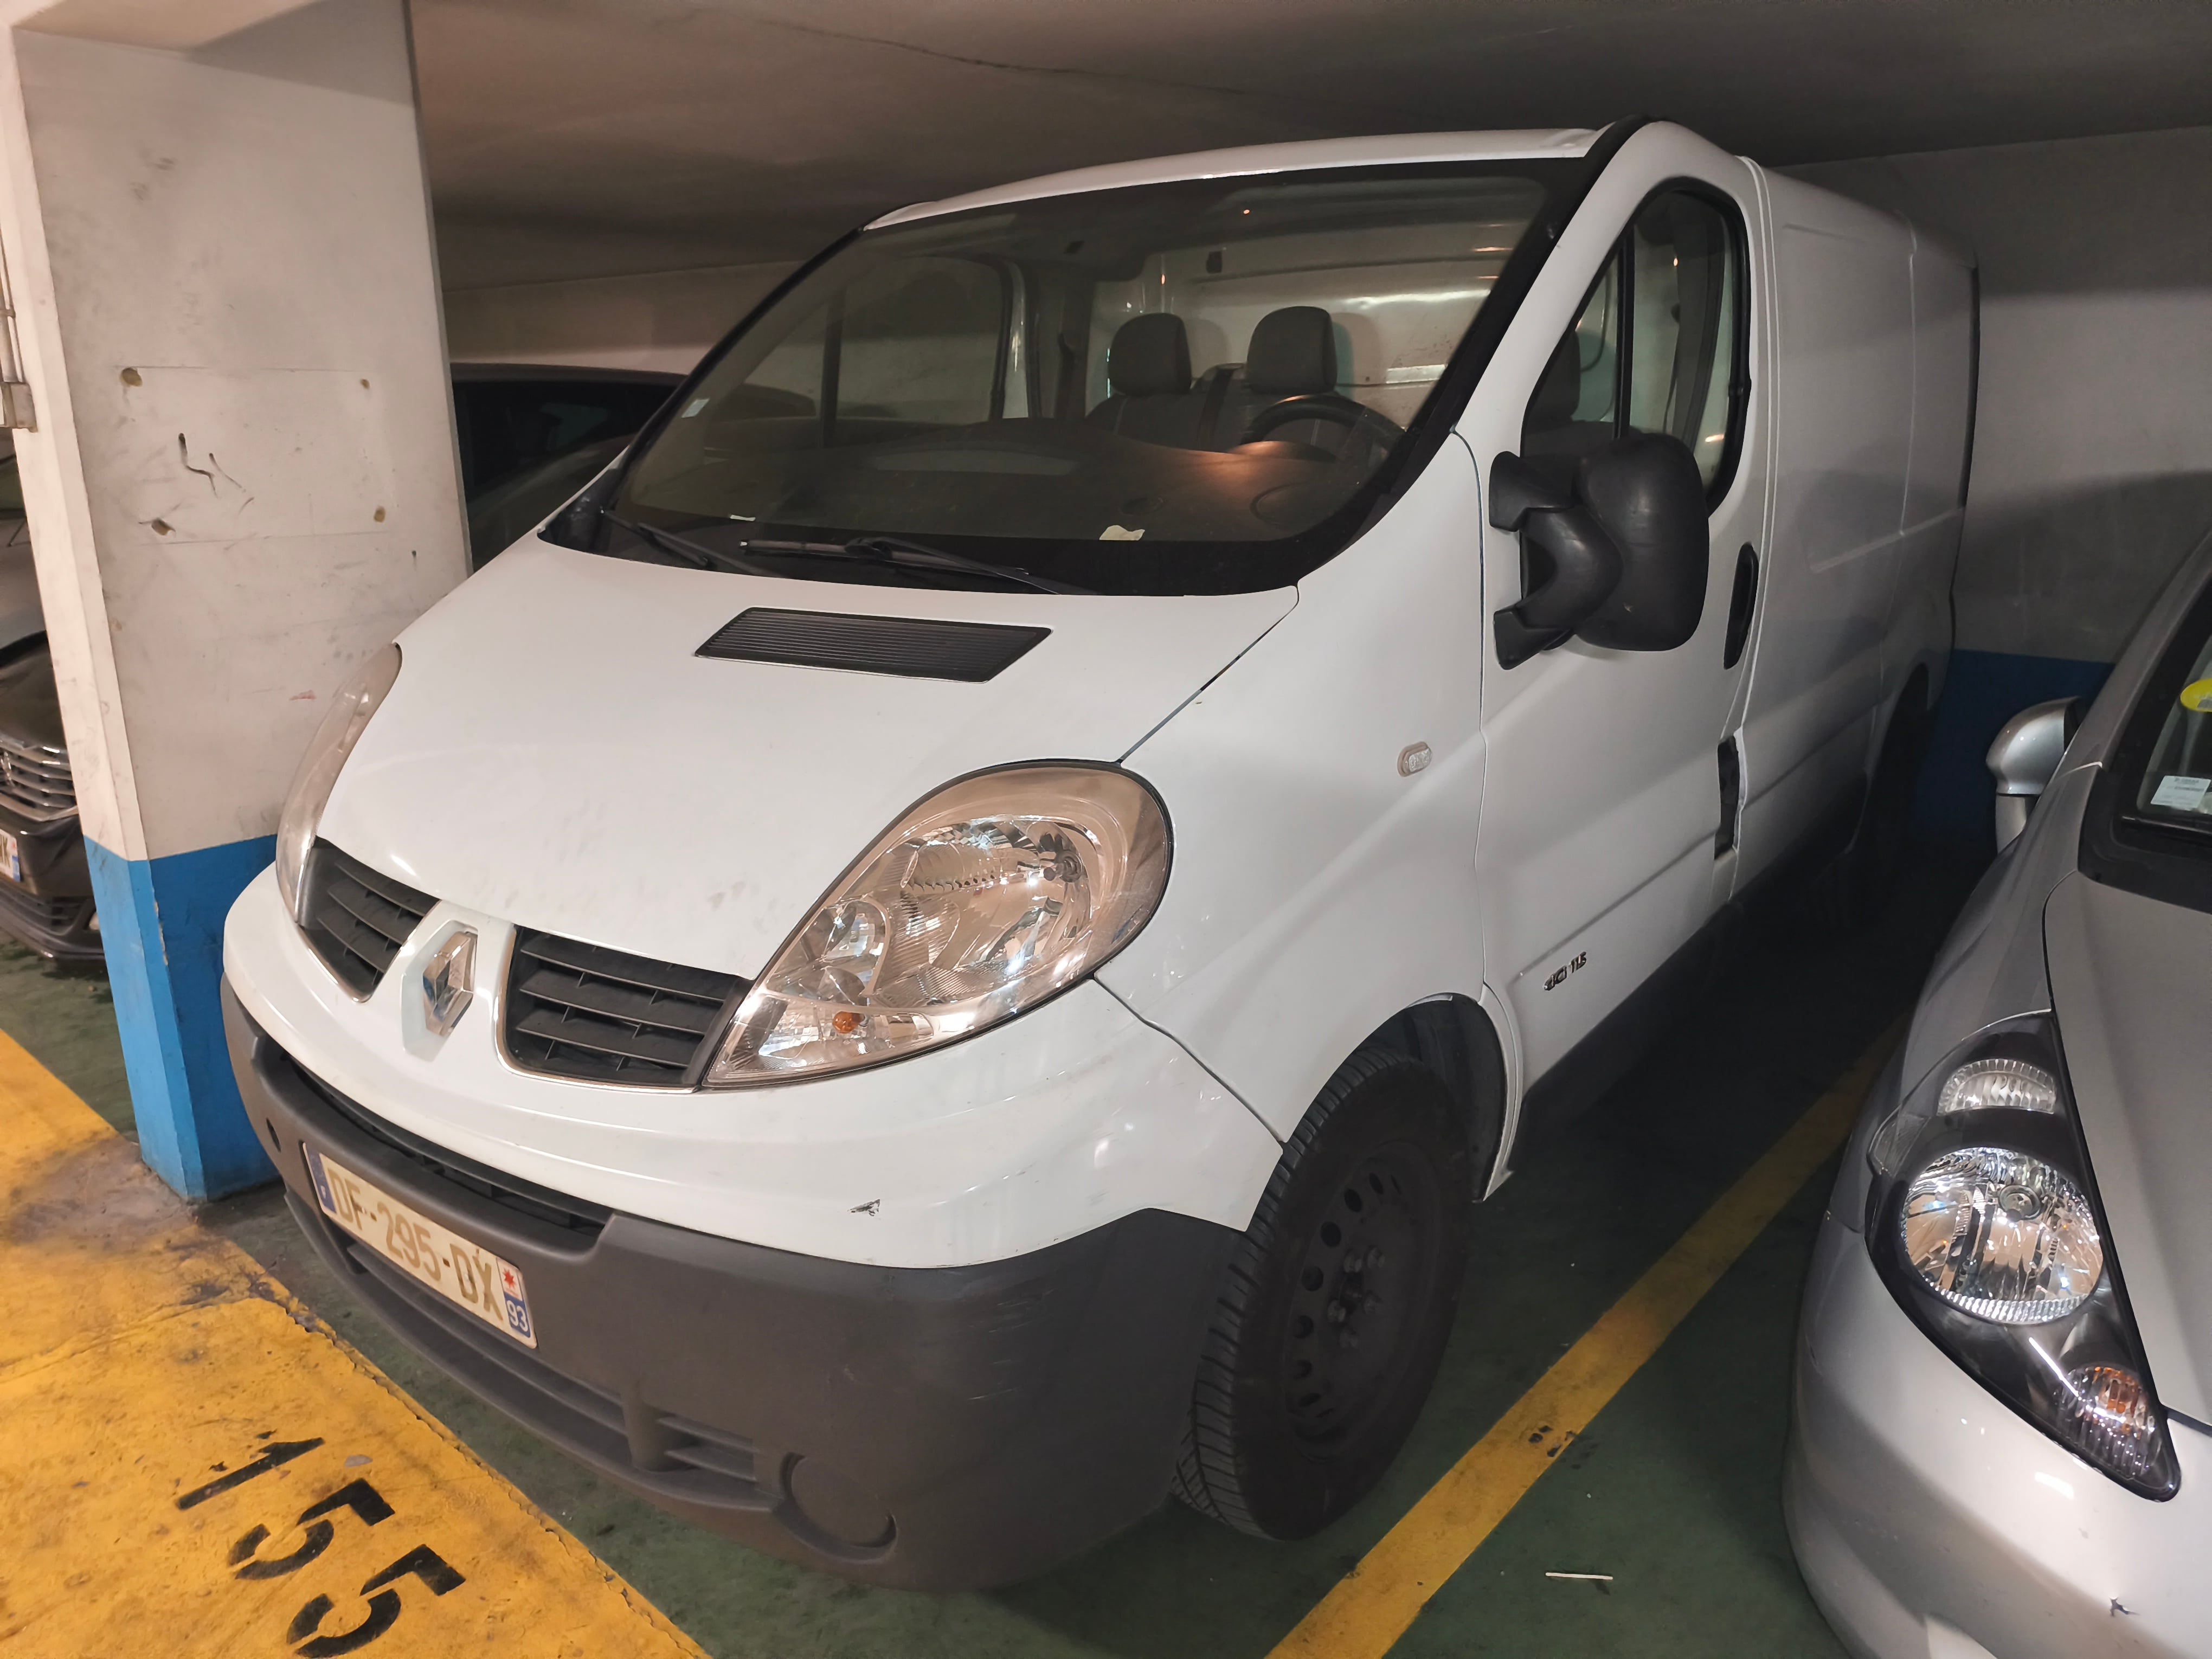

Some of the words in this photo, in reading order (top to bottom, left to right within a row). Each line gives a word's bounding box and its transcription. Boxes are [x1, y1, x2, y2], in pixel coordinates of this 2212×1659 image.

[327, 1167, 504, 1321] DF-295-DX
[506, 1300, 528, 1332] 93
[175, 1436, 466, 1659] 155
